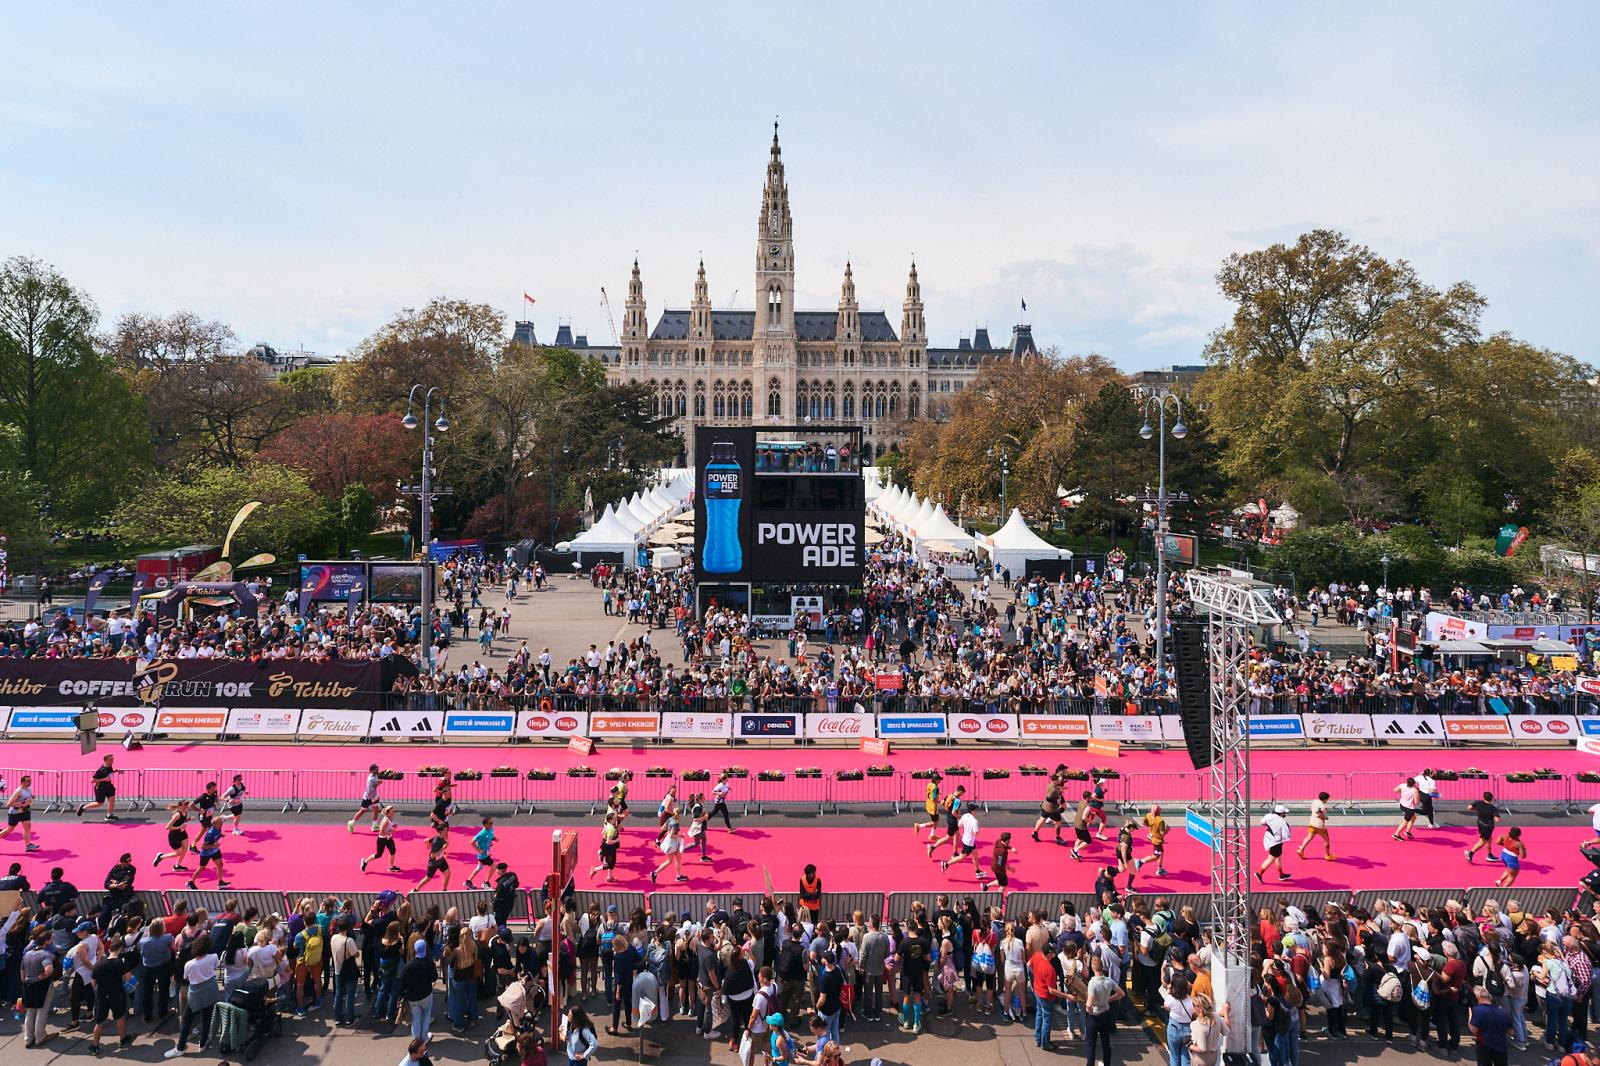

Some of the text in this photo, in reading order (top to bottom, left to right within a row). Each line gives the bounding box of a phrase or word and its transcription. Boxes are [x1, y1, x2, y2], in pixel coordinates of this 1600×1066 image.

[708, 474, 738, 482] POWER
[721, 482, 738, 490] ADE
[758, 523, 856, 544] POWER
[803, 545, 856, 567] ADE
[1439, 626, 1456, 636] Sport
[0, 678, 47, 695] hibo
[166, 681, 211, 697] RUN
[215, 682, 255, 697] 10K
[292, 681, 358, 698] Tchibo
[323, 720, 360, 732] Tchibo
[528, 719, 548, 728] Hervis
[556, 719, 577, 728] Hervis
[960, 721, 980, 730] Hervis
[988, 721, 1008, 730] Hervis
[1327, 725, 1365, 735] Tchibo
